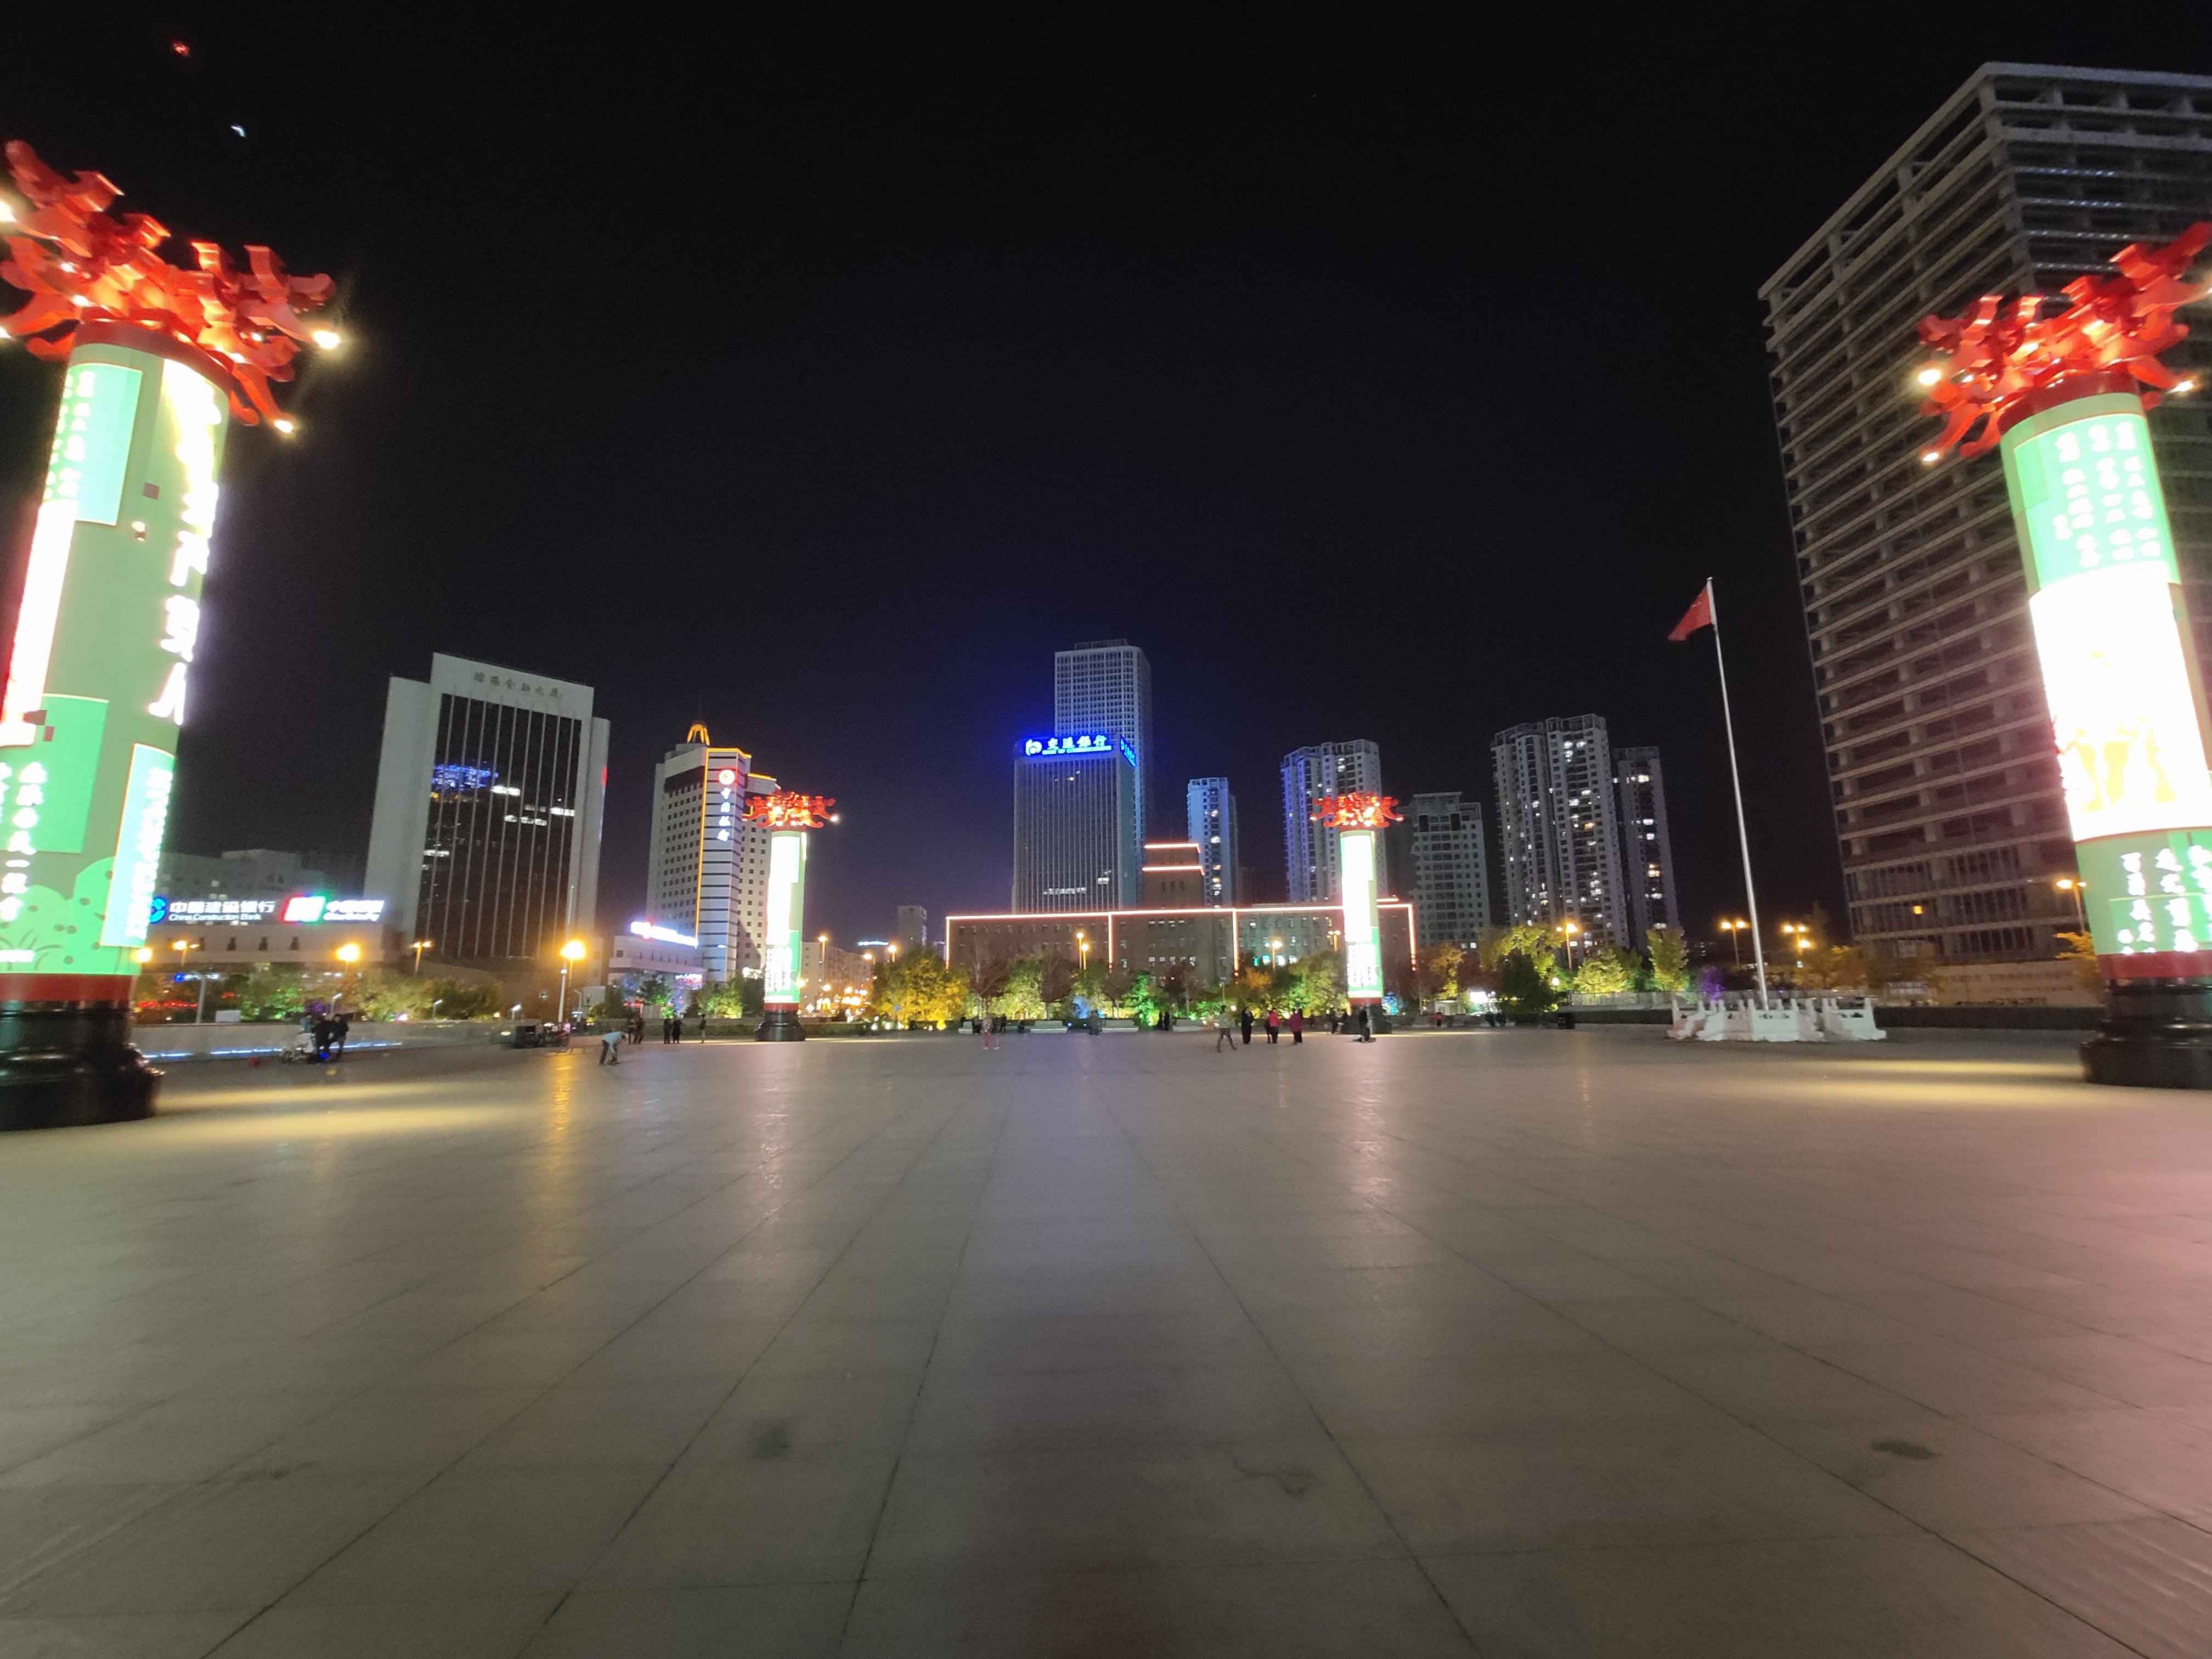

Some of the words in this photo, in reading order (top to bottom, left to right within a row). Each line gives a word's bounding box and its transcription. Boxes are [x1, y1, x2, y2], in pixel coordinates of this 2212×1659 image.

[1047, 735, 1107, 750] 交通银行
[170, 901, 275, 913] 中国建设银行
